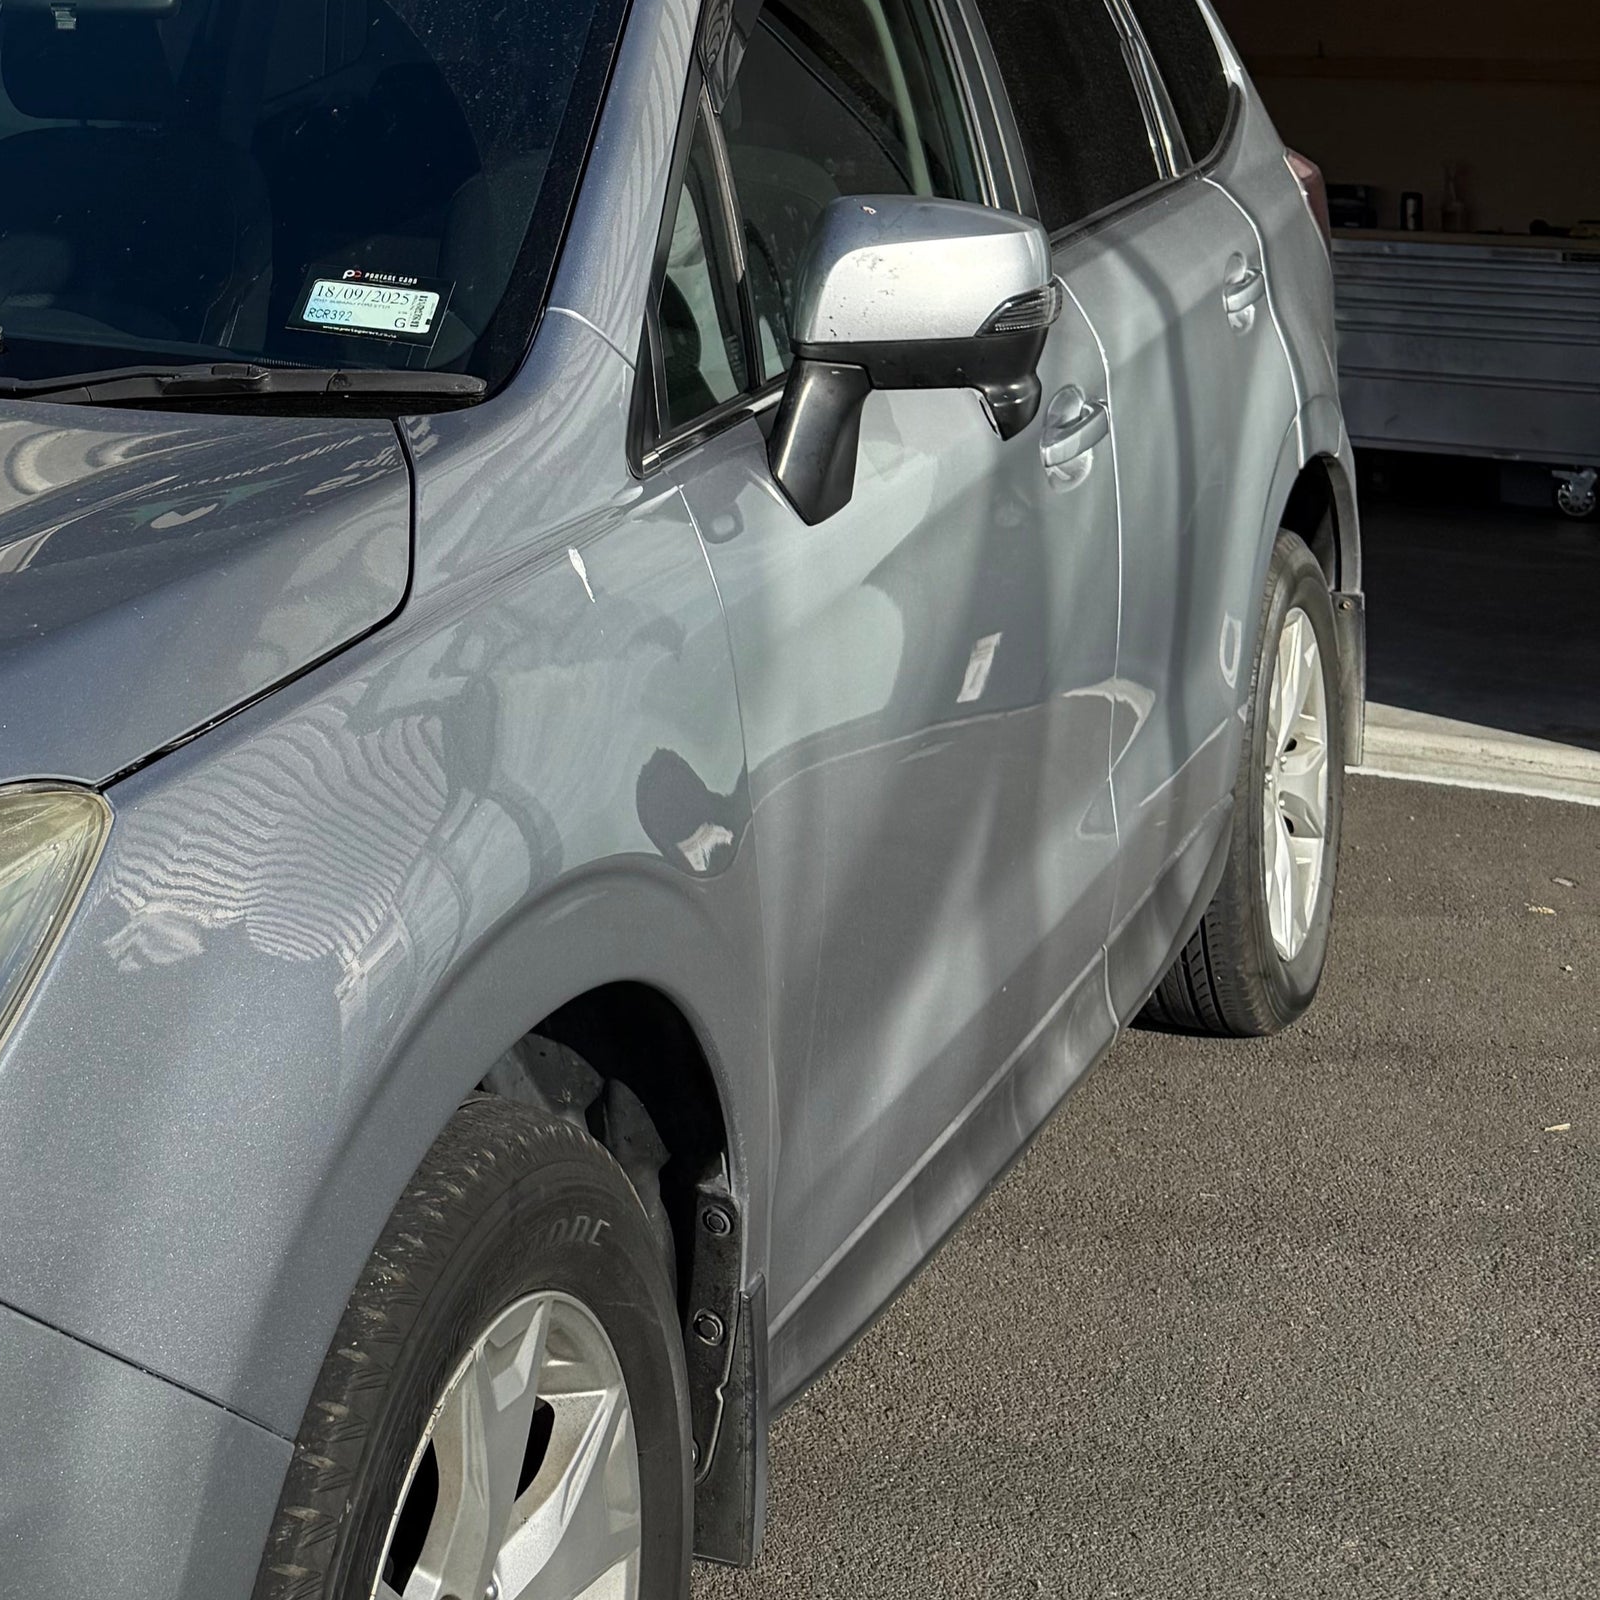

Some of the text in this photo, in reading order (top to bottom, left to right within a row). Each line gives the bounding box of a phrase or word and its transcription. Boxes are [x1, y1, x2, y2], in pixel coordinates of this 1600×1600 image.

[315, 284, 410, 305] 18/09/2025
[306, 307, 354, 323] RCR392
[394, 316, 407, 329] G
